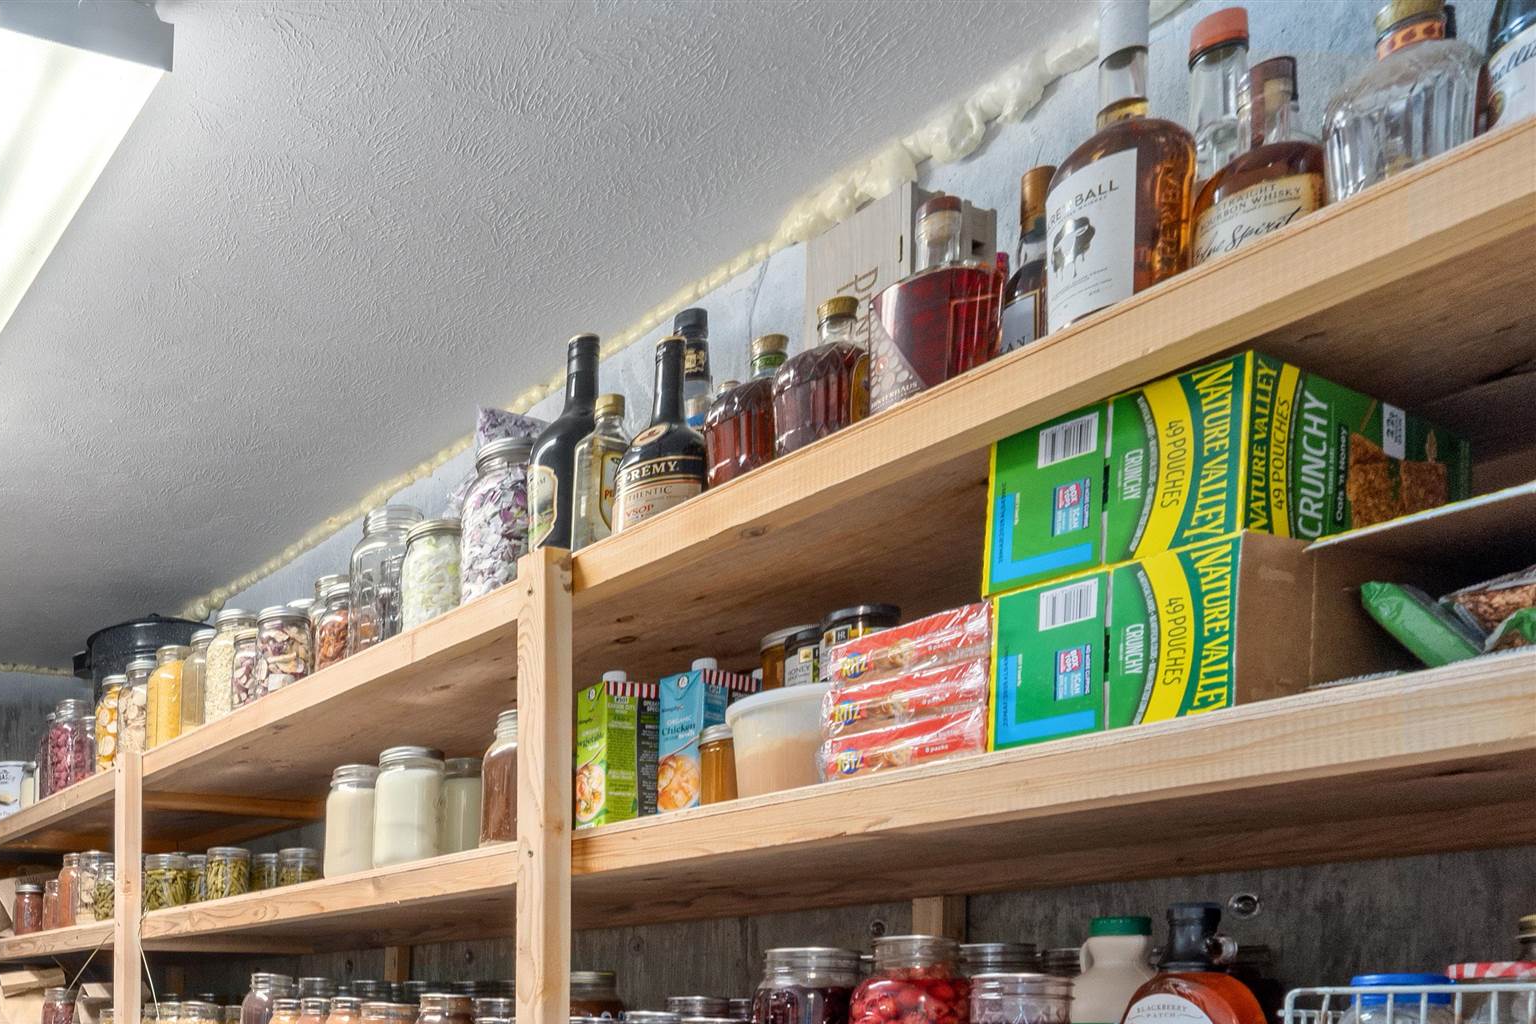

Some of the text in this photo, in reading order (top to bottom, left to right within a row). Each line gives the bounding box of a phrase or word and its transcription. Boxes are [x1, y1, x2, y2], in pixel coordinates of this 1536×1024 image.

[1160, 418, 1186, 509] 49 POUCHES
[1182, 361, 1234, 539] NATURE VALLEY
[1247, 357, 1279, 533] NATURE VALLEY
[1271, 397, 1292, 511] 49 POUCHES
[1296, 389, 1329, 539] CRUNCHY
[1337, 426, 1347, 472] Honey
[1122, 449, 1144, 501] CRUNCHY
[625, 503, 654, 518] VSOP
[1189, 541, 1233, 639] NATURE
[841, 653, 870, 677] RITZ
[1124, 623, 1145, 675] CRUNCHY
[1163, 596, 1187, 687] 49 POUCHES
[661, 722, 696, 736] Chicken
[833, 703, 862, 725] RITZ
[836, 751, 864, 773] RITZ
[1136, 1003, 1188, 1014] BLACKBERRY
